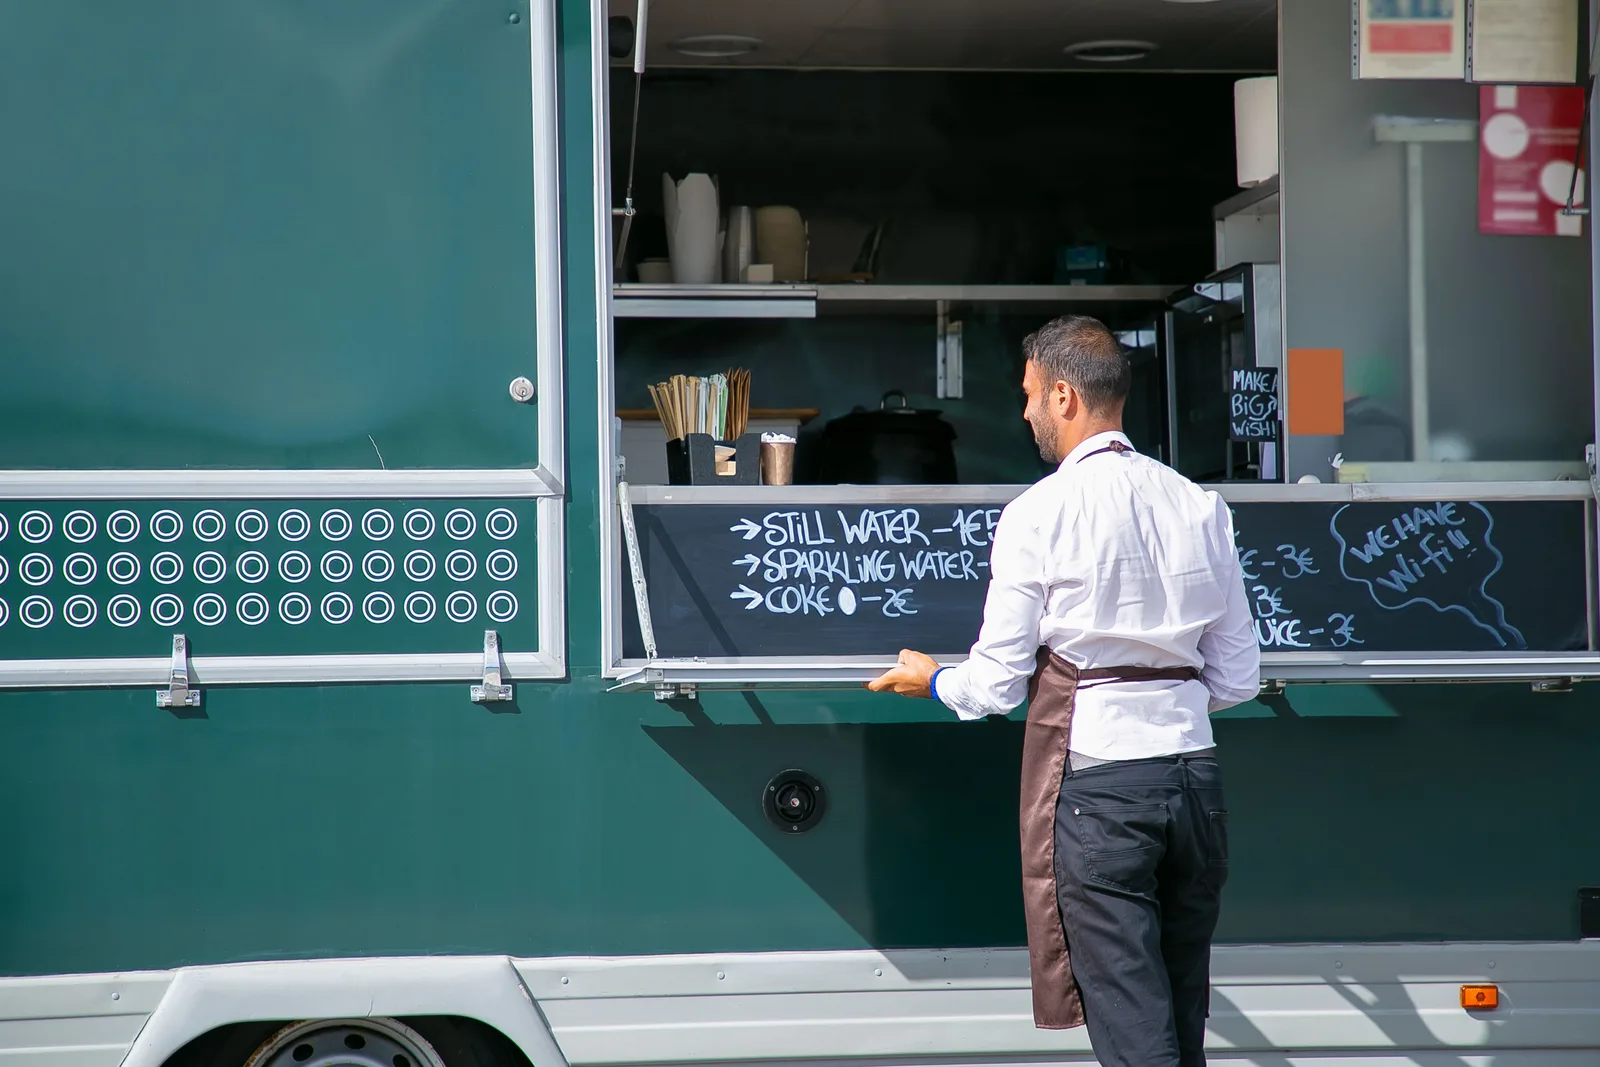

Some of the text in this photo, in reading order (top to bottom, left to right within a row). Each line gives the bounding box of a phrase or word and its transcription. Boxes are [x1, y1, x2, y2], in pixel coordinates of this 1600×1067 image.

[1232, 369, 1270, 393] MAKE
[837, 508, 930, 546] WATER
[1349, 501, 1466, 564] WE HAVE
[765, 584, 834, 616] COKE
